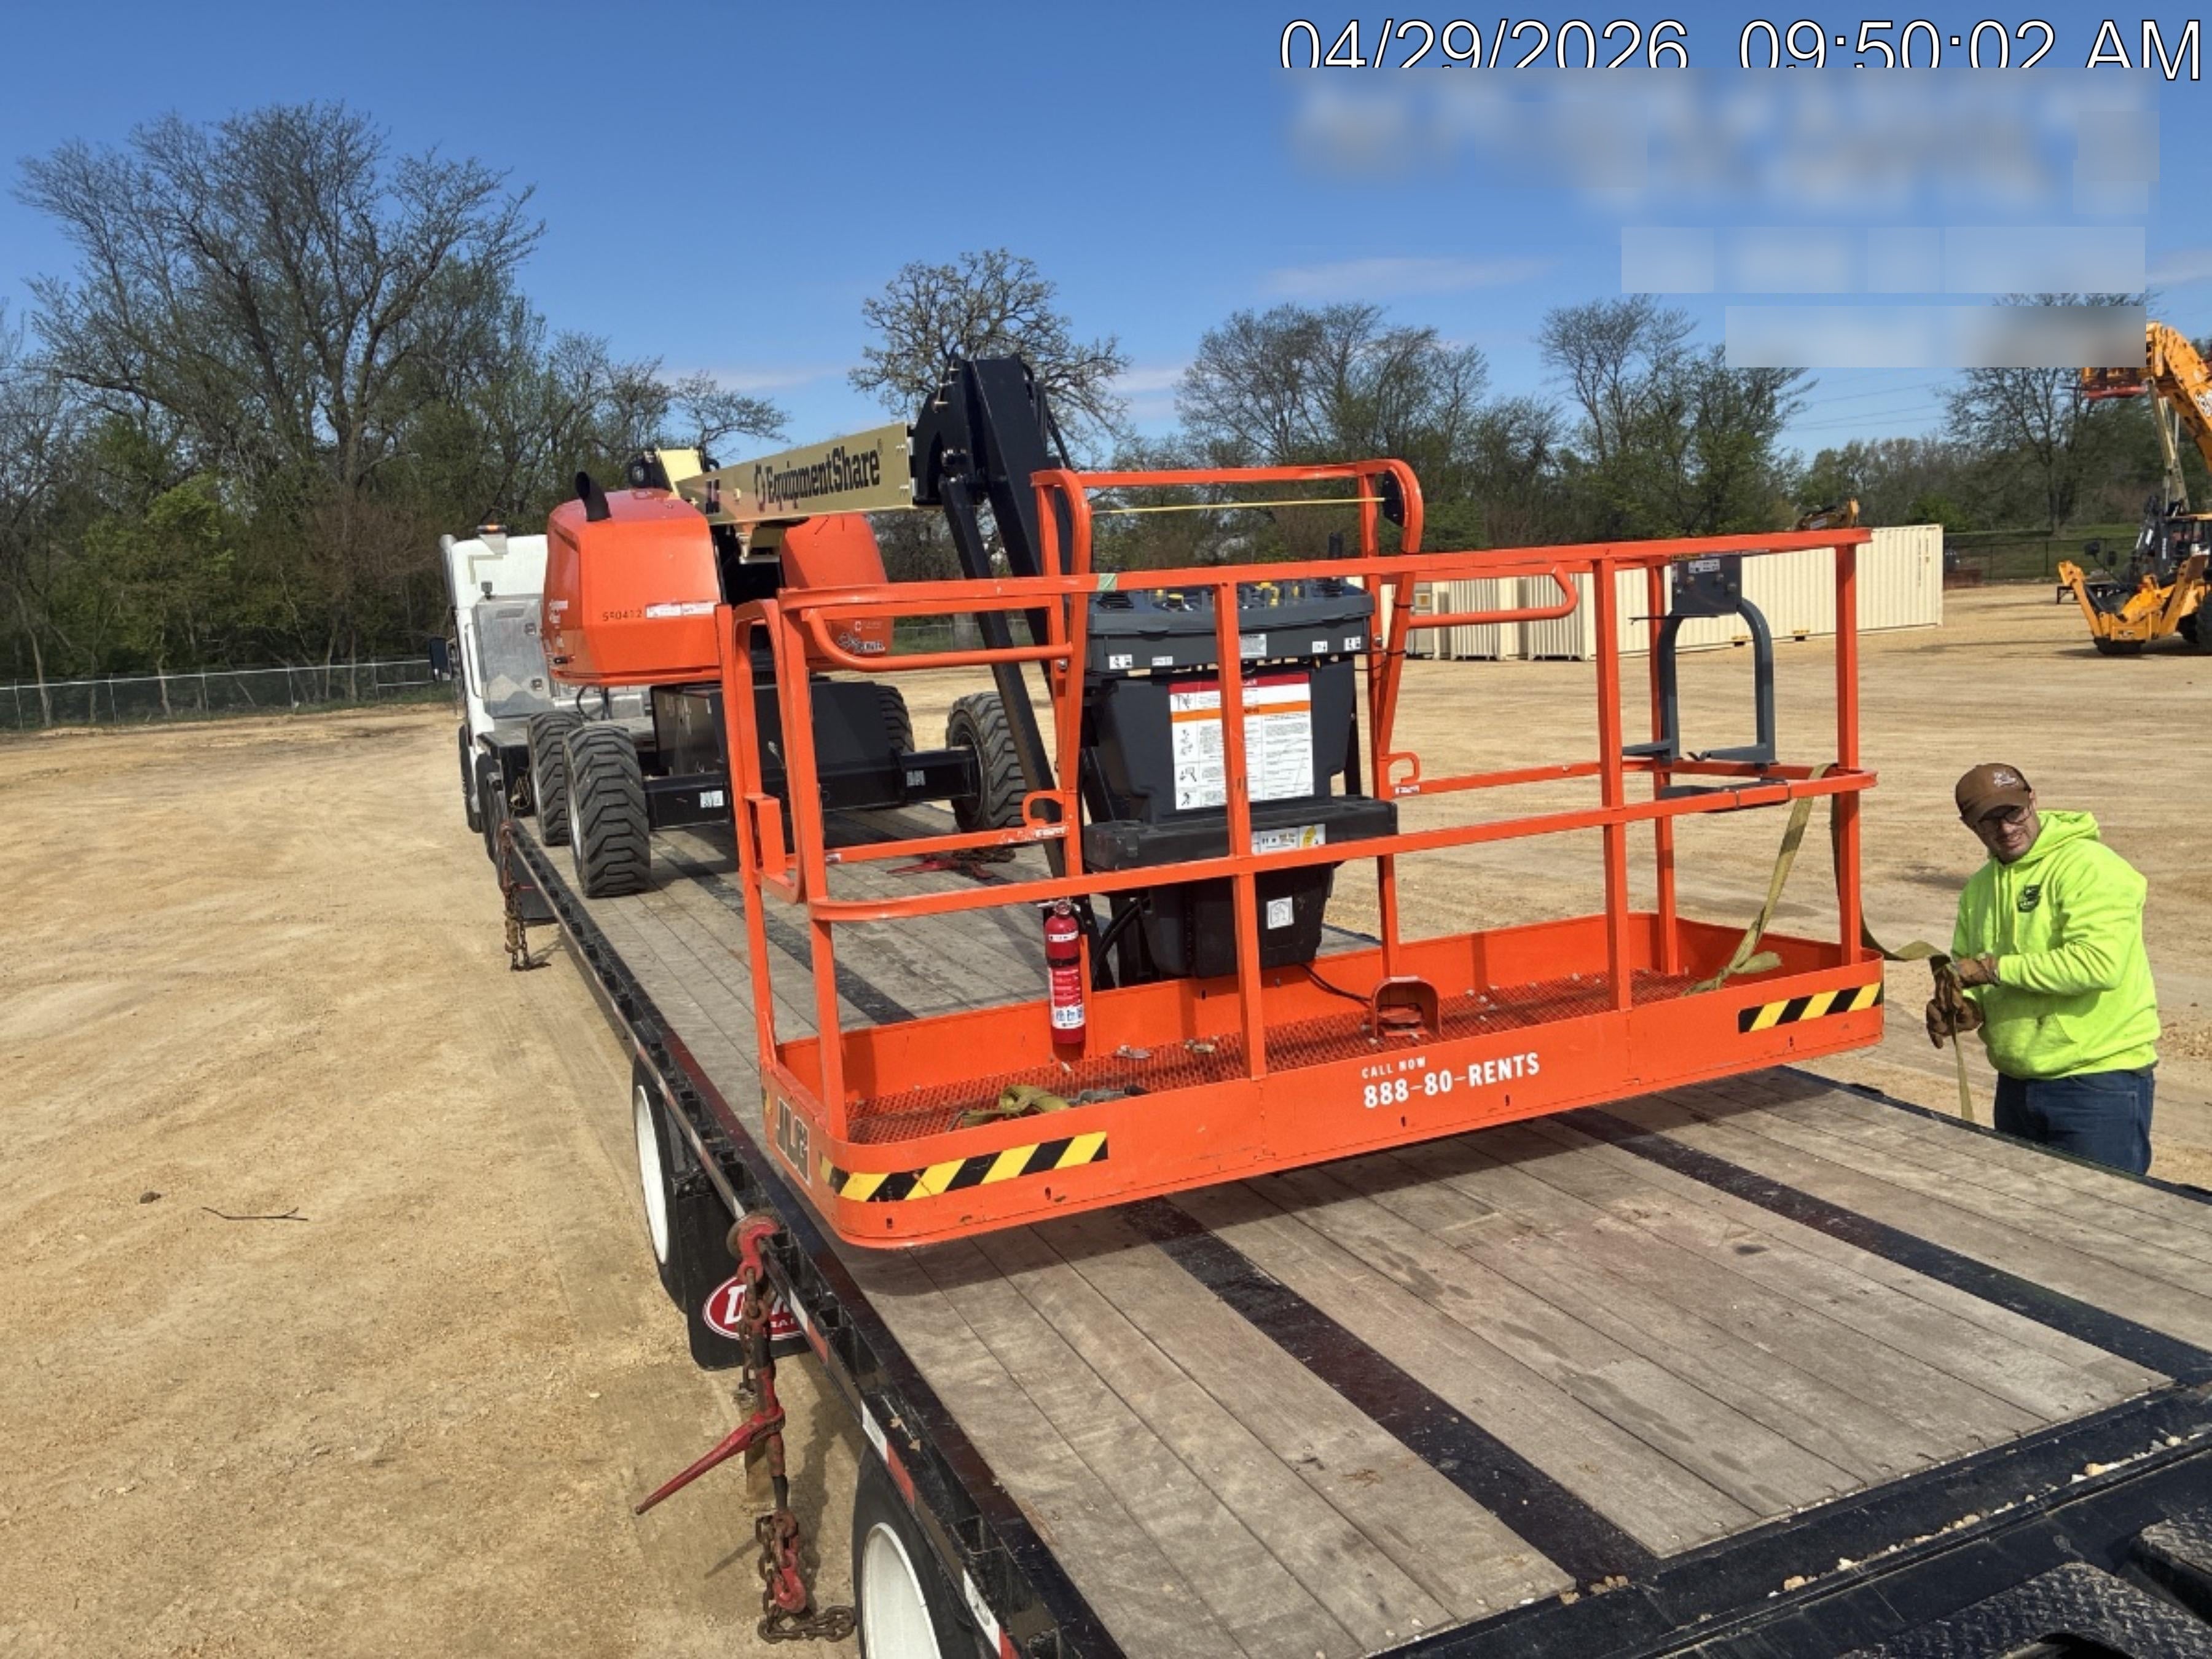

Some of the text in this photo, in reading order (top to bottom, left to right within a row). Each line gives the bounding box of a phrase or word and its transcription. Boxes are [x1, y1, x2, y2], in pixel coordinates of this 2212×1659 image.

[766, 446, 880, 512] EquipmentShare
[1362, 1056, 1426, 1079] CALL NOW
[1363, 1052, 1540, 1108] 888-80-RENTS
